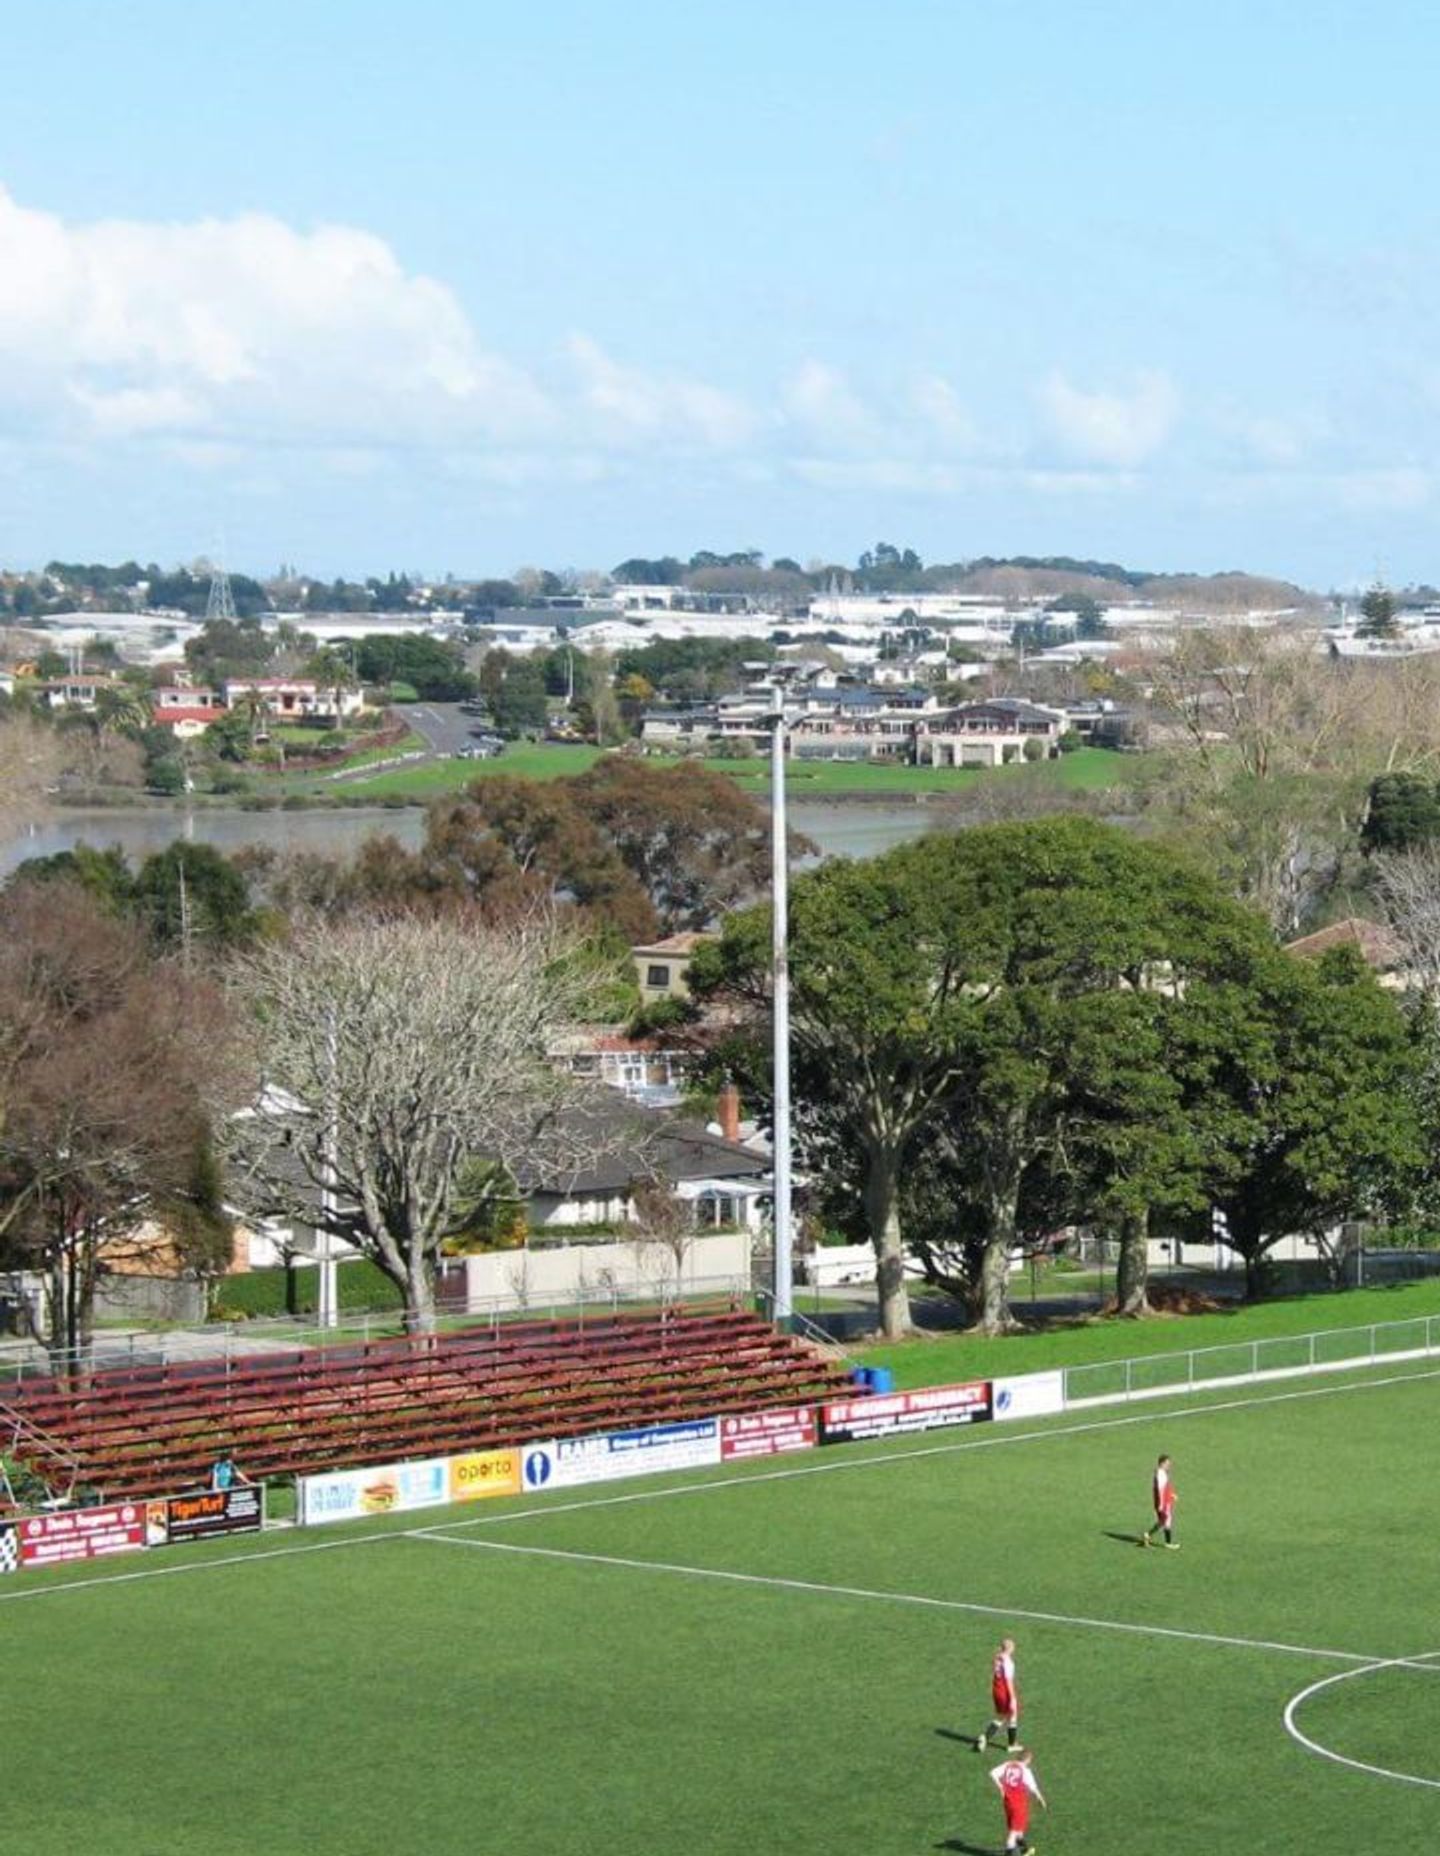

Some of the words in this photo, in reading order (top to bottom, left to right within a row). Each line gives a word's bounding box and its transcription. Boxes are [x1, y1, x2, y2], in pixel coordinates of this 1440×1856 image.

[560, 1438, 609, 1459] RAMS
[458, 1460, 511, 1482] oporto
[170, 1494, 225, 1519] TigerTurf
